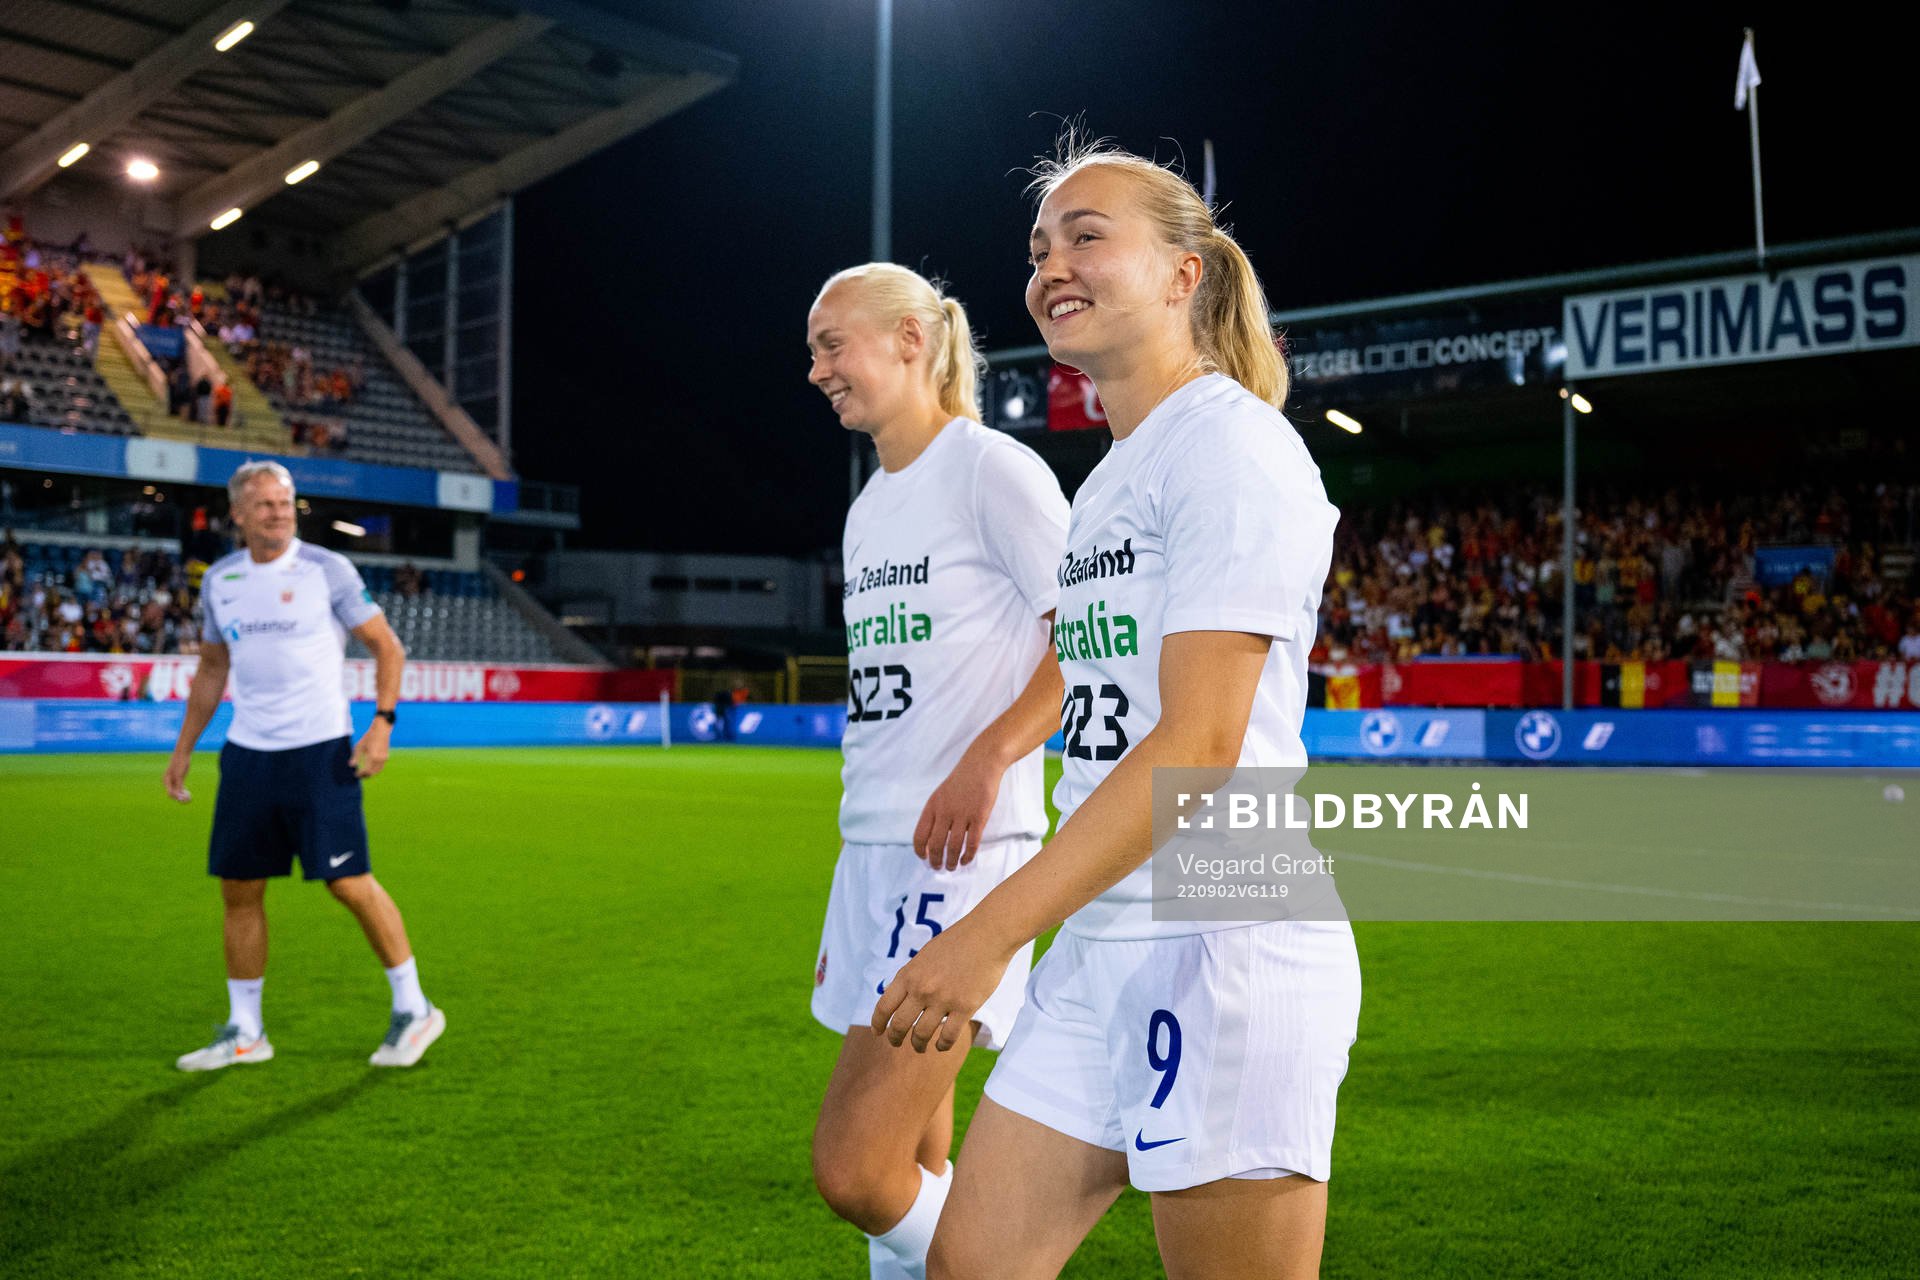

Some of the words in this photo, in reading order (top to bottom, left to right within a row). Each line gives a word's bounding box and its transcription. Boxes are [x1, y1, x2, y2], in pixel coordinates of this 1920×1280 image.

[1435, 327, 1557, 366] CONCEPT
[1571, 266, 1907, 370] VERIMASS
[859, 555, 929, 593] Zealand
[1064, 538, 1135, 587] Zealand
[1055, 600, 1138, 662] stralia
[342, 664, 484, 700] BEGIUM
[848, 665, 913, 722] 023
[1061, 683, 1129, 761] 023
[887, 893, 945, 958] 15
[1147, 1008, 1182, 1109] 9
